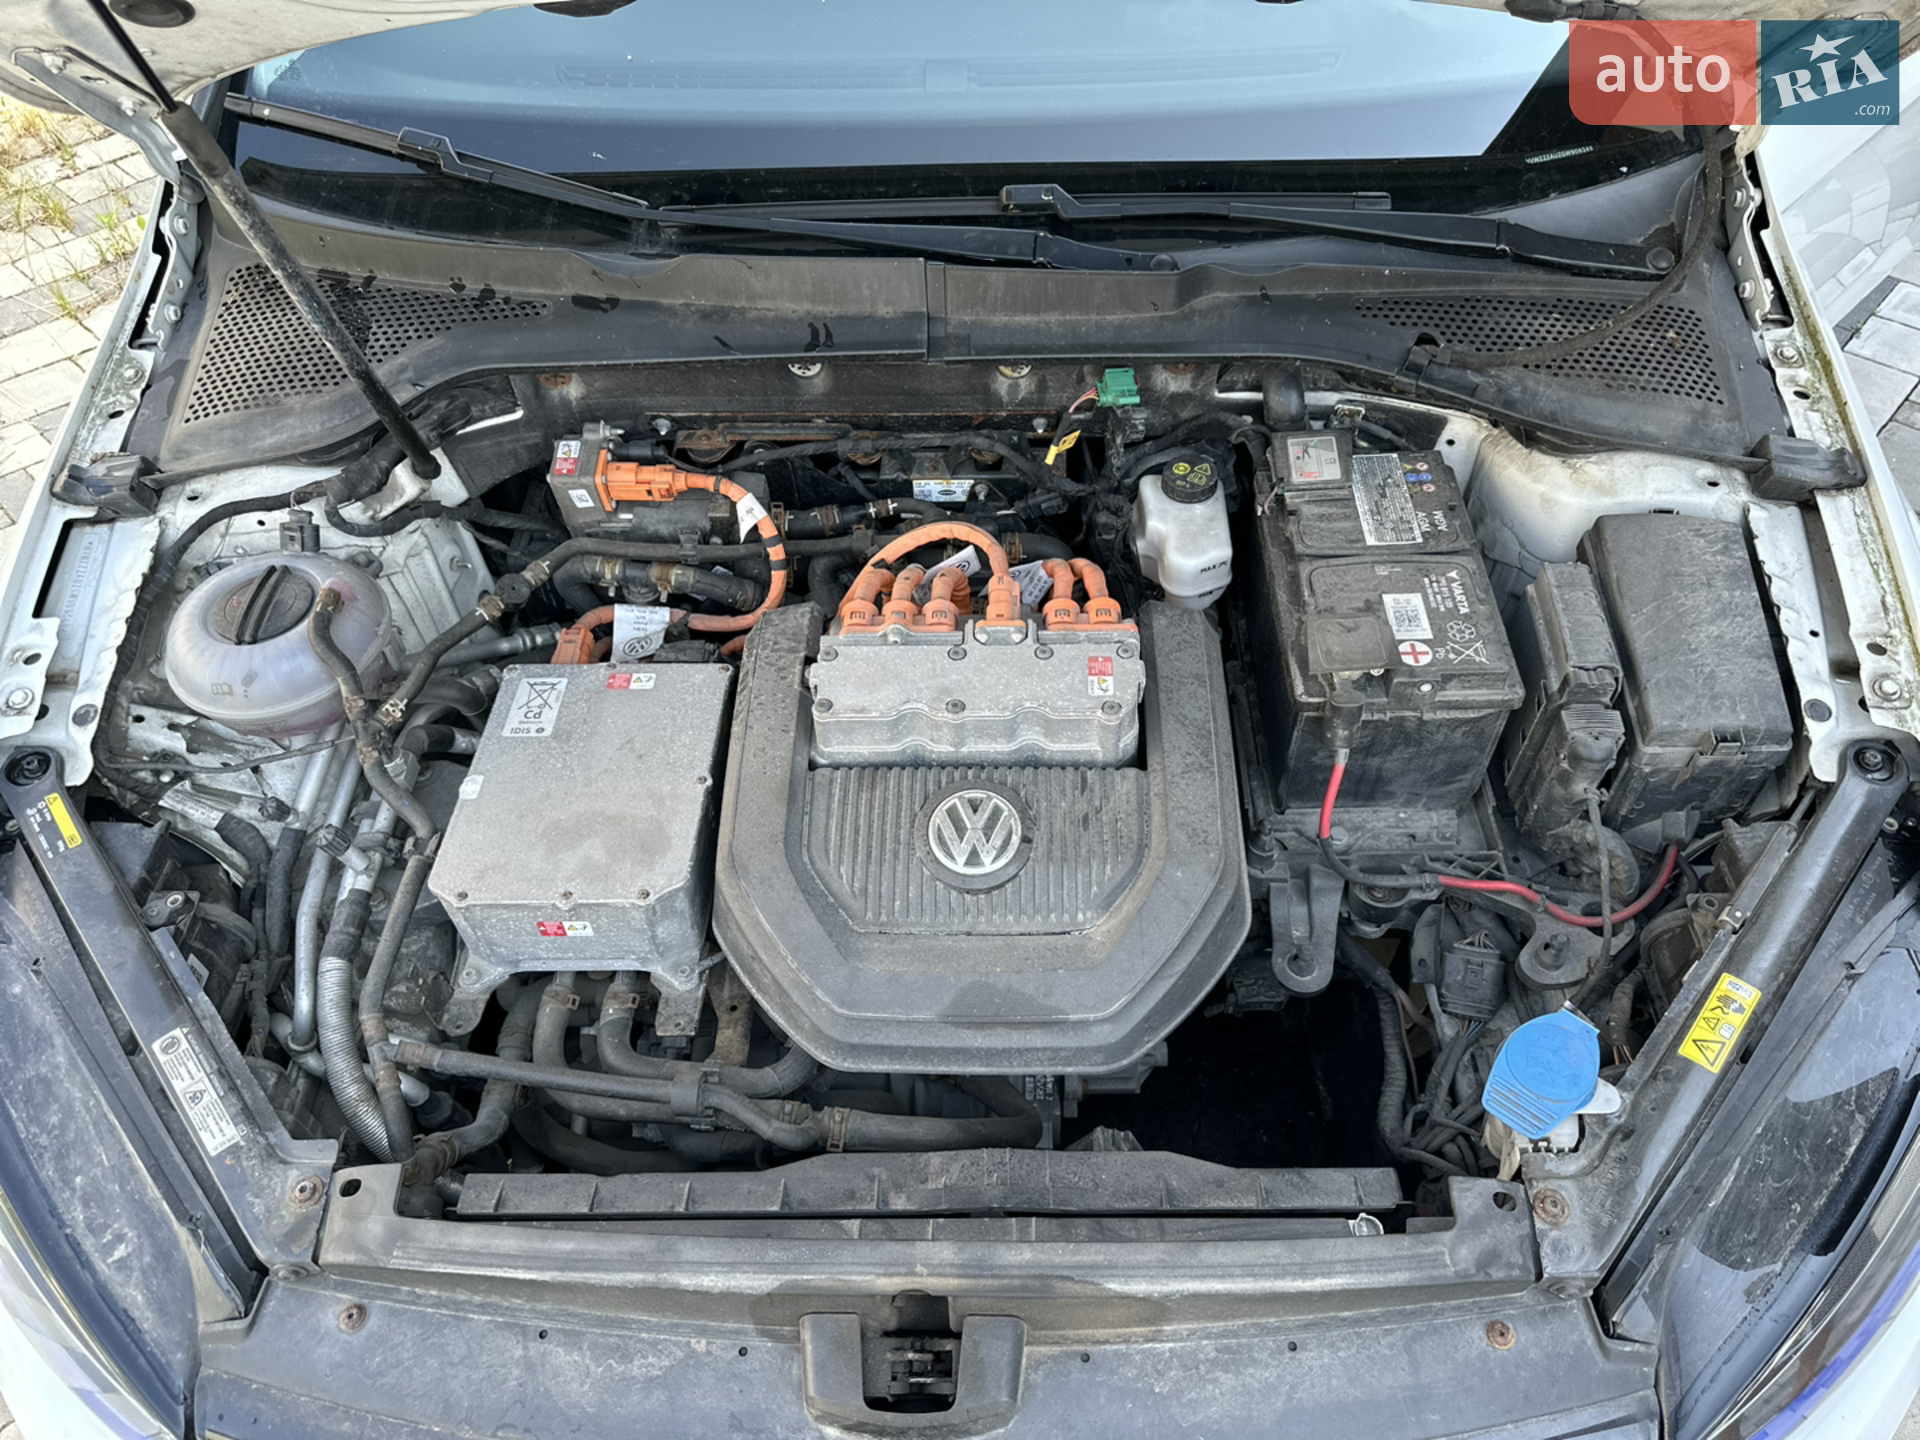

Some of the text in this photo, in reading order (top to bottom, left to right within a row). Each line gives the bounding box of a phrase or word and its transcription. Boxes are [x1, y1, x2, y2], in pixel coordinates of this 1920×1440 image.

[1200, 564, 1217, 574] MAX
[1450, 580, 1470, 615] VARTA
[524, 710, 543, 720] Cd
[510, 727, 532, 735] IDIS
